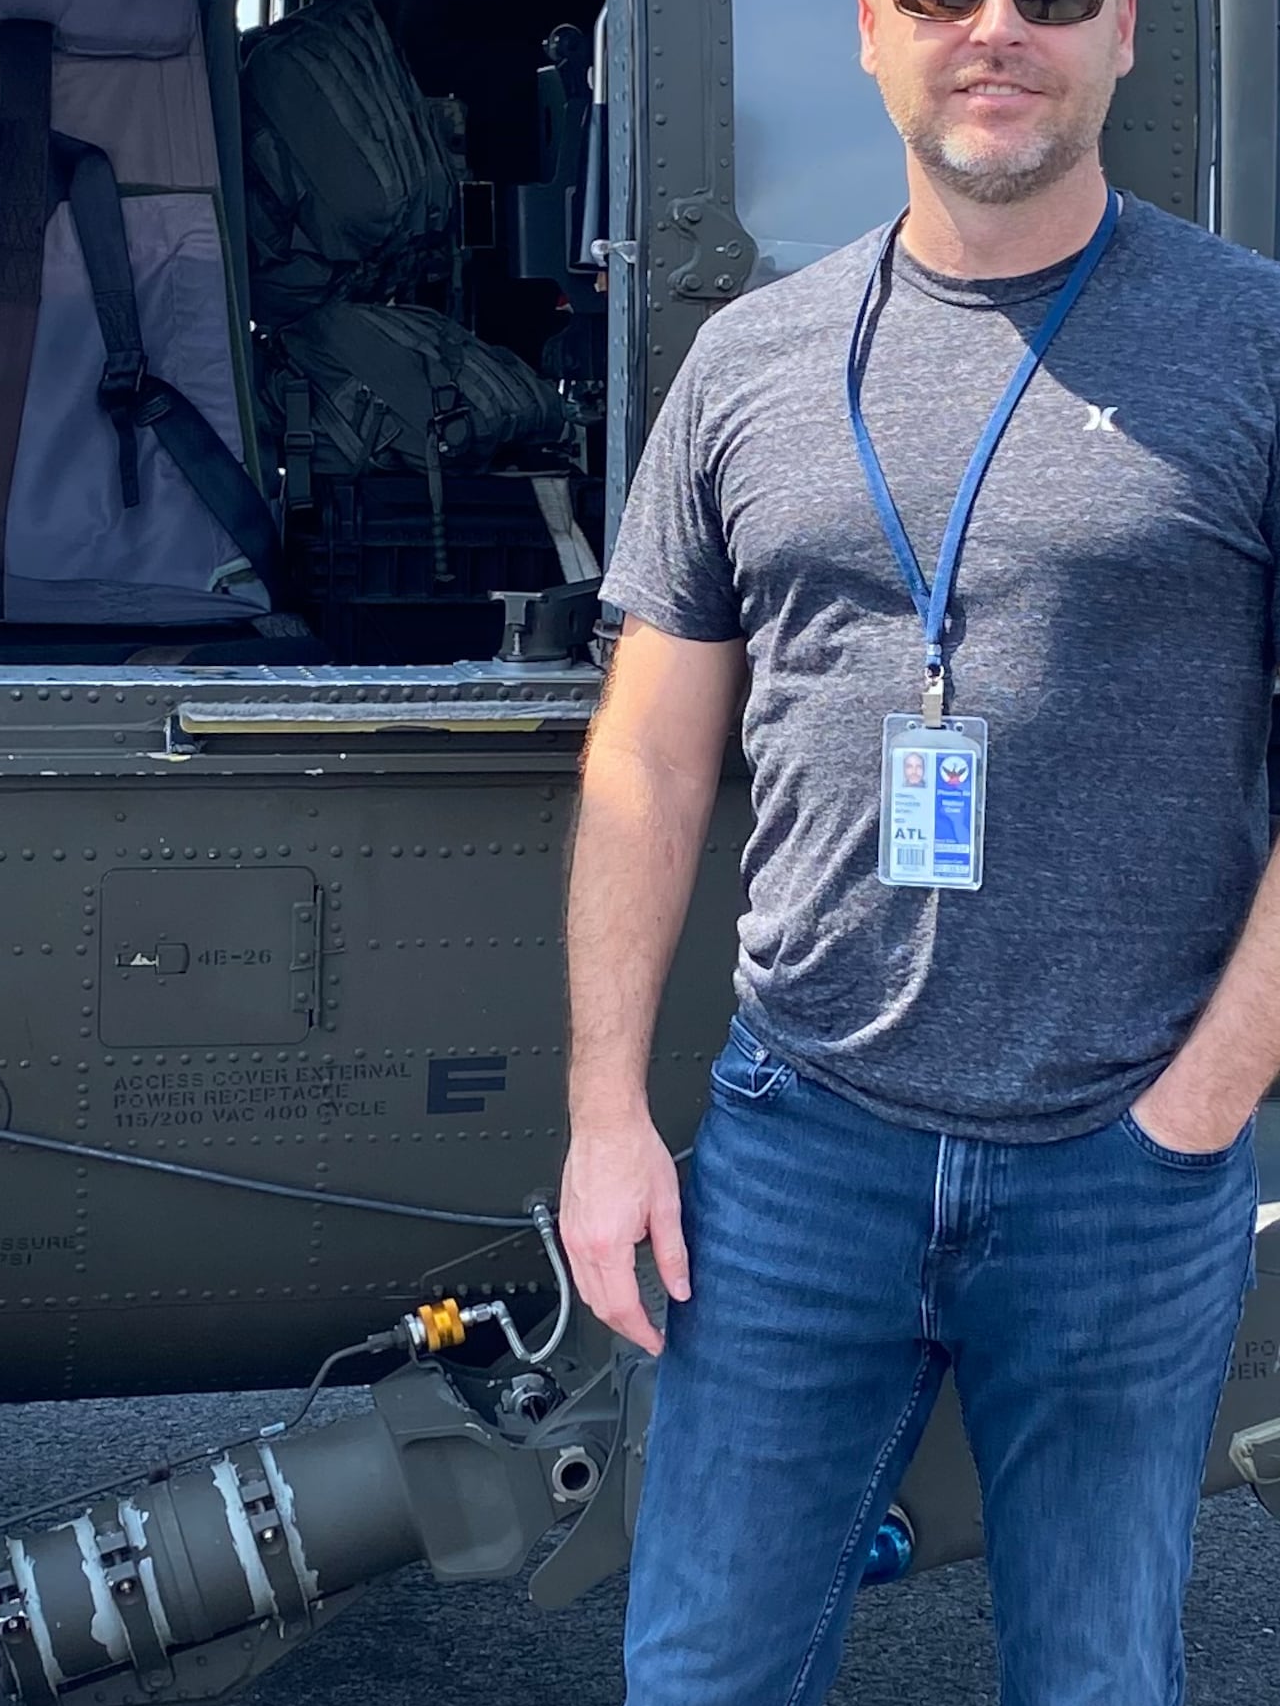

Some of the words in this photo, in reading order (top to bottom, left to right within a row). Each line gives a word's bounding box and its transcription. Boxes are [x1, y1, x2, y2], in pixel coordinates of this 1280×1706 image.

[894, 828, 926, 840] ATL
[113, 1072, 204, 1092] ACCESS
[212, 1069, 289, 1087] COVER
[294, 1061, 412, 1083] EXTERNAL
[114, 1093, 196, 1109] POWER
[203, 1083, 350, 1106] RECEPTACLE
[114, 1111, 203, 1129] 115/200
[212, 1108, 255, 1124] VAC
[263, 1104, 308, 1121] 400
[317, 1100, 388, 1119] CYCLE
